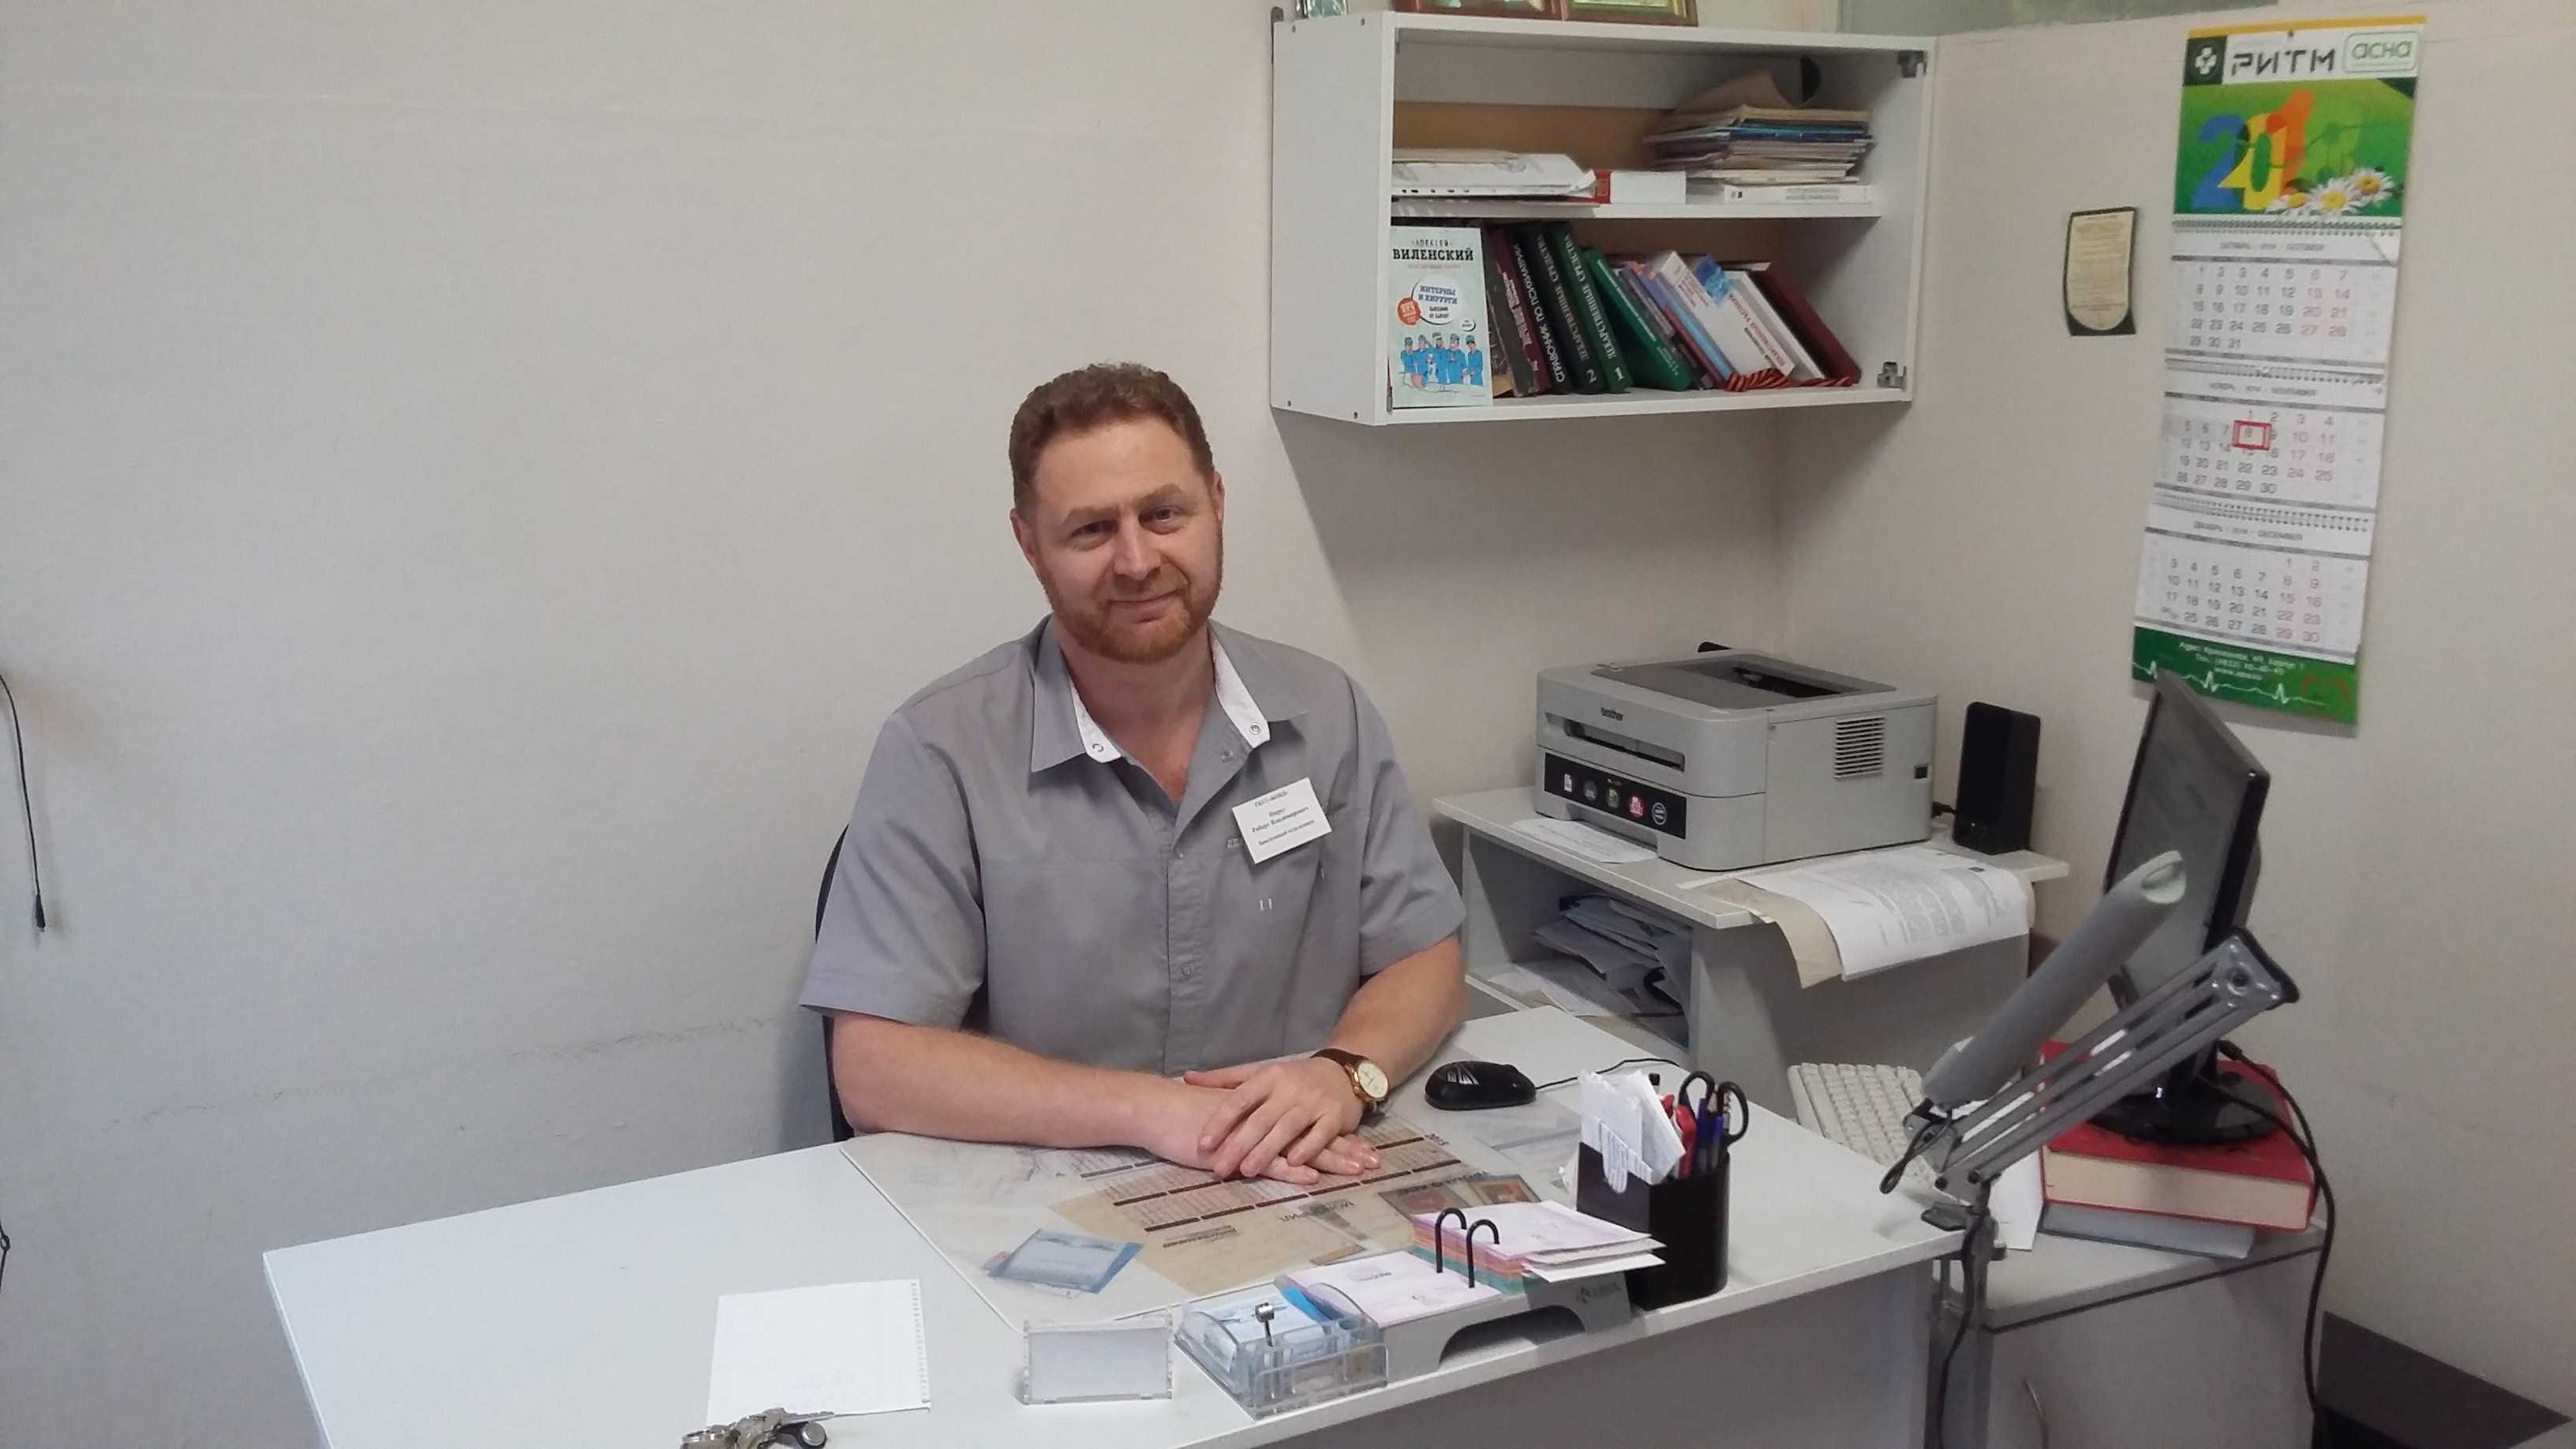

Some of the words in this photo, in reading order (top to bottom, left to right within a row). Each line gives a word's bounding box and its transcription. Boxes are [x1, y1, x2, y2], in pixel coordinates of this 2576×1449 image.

[2231, 48, 2335, 77] РИТМ
[1392, 247, 1474, 261] ВИЛЕНСКИЙ
[1563, 234, 1586, 283] СРЕДСТВА
[1533, 307, 1544, 323] ПО
[1581, 283, 1616, 360] ЛЕКАРСТВЕННЫЕ
[1540, 323, 1565, 383] СПРАВОЧНИК
[1586, 369, 1597, 384] 2
[1615, 367, 1624, 380] 1
